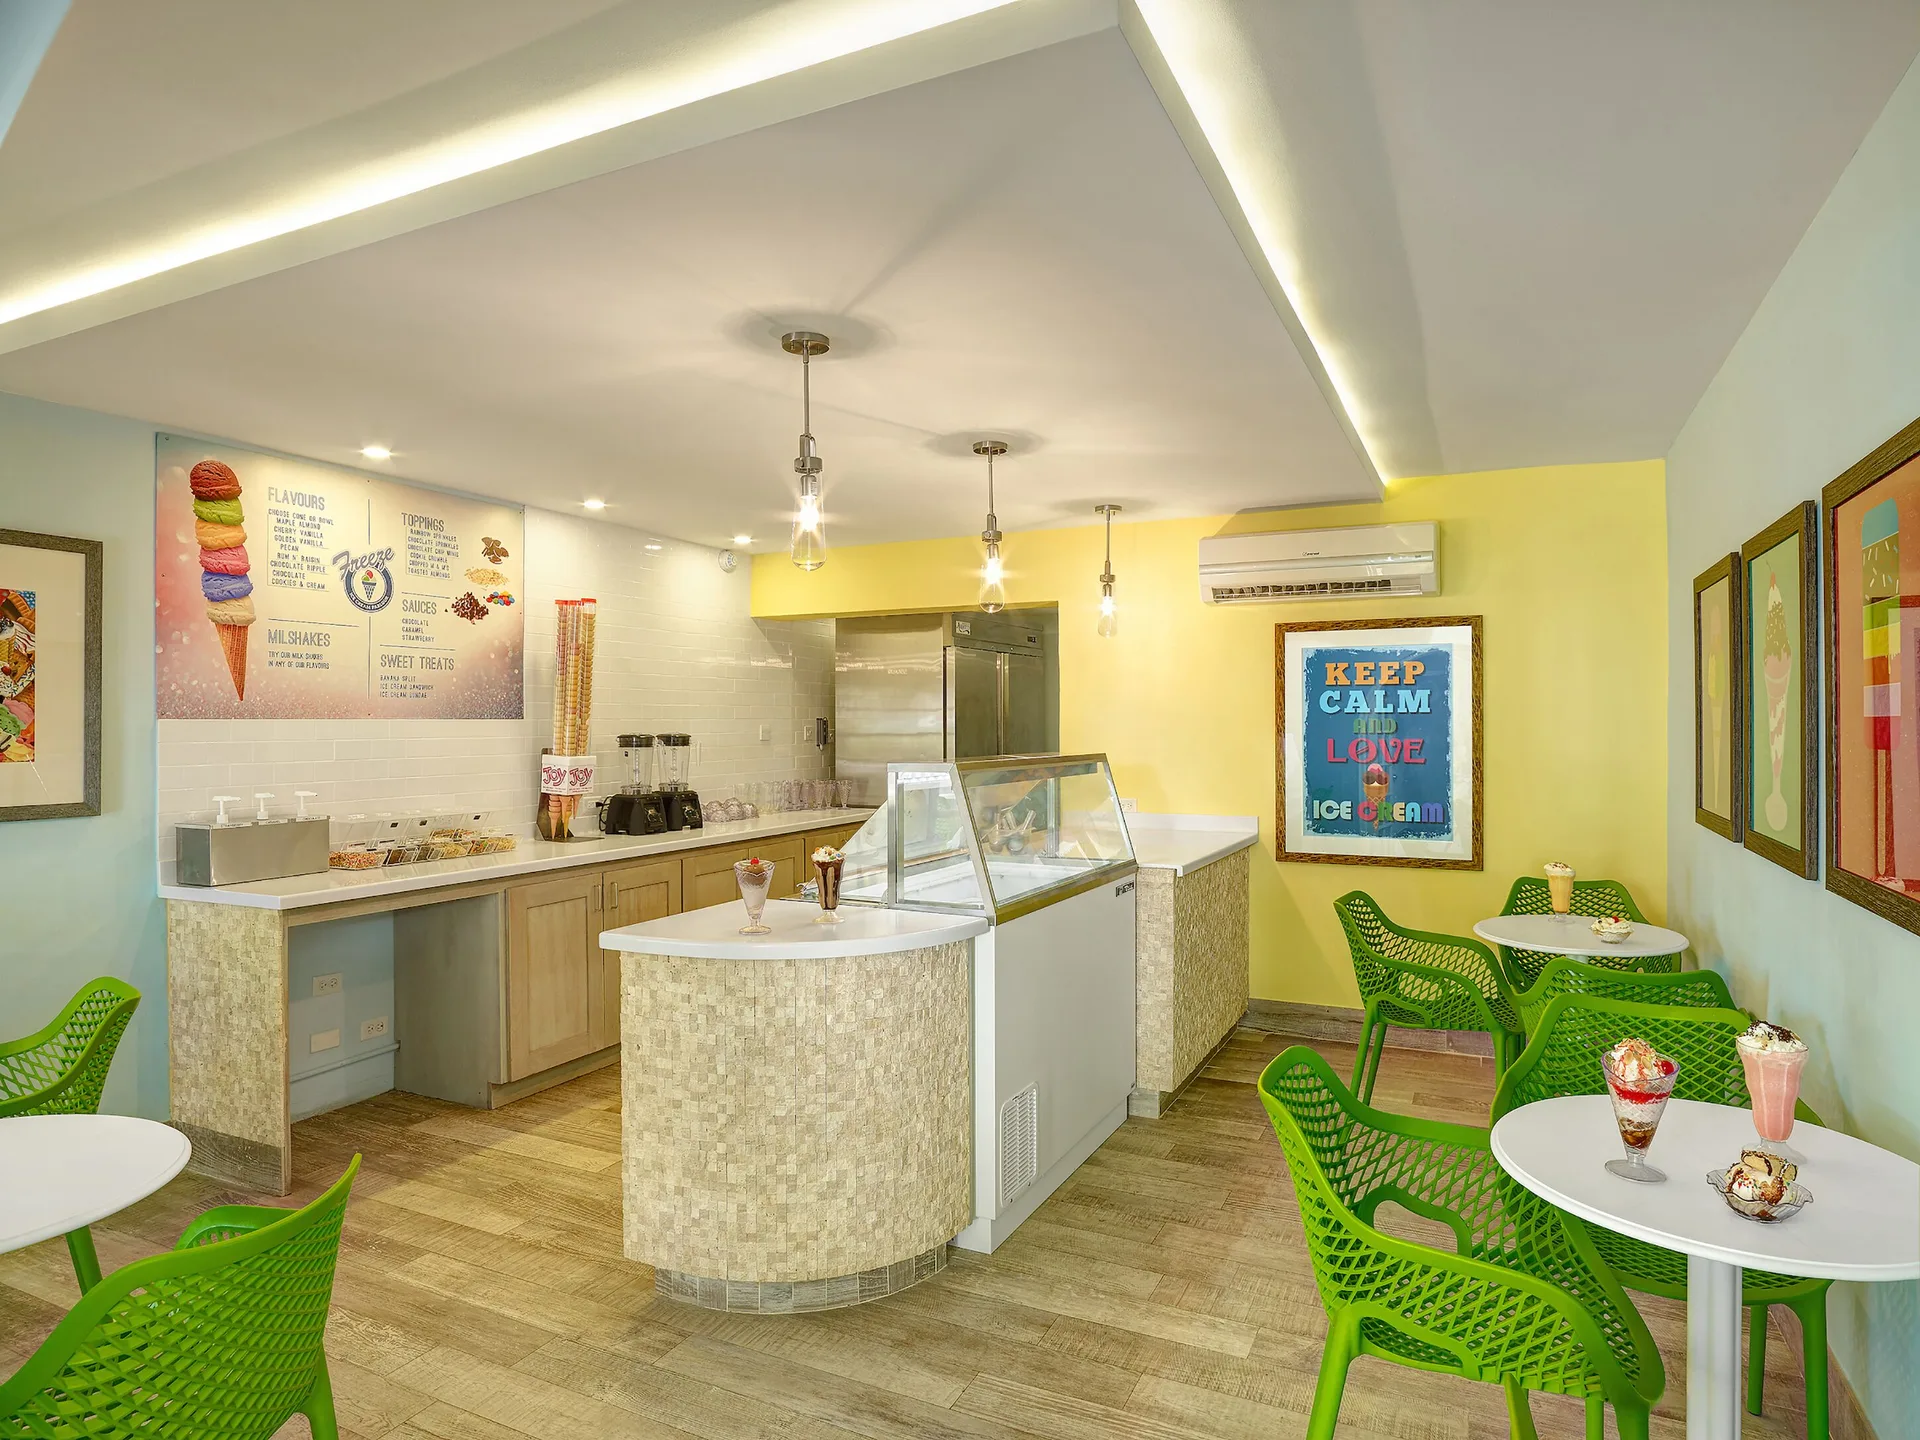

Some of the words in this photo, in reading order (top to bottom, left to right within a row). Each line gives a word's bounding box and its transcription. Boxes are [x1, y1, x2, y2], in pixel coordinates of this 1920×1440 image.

[268, 486, 325, 511] FLAVOURS
[268, 508, 289, 518] CHOOSE
[292, 512, 306, 521] CONE
[318, 516, 334, 526] BOWL
[276, 517, 295, 527] MAPLE
[299, 521, 321, 530] ALMOND
[401, 512, 445, 533] TOPPINGS
[273, 525, 296, 535] CHERRY
[300, 529, 323, 539] VANILLA
[410, 528, 431, 537] RAINBOW
[274, 534, 296, 543] GOLDEN
[299, 538, 323, 547] VANILLA
[280, 543, 299, 551] PECAN
[407, 536, 433, 546] CHOCOLATE
[407, 543, 433, 553] CHOCOLATE
[277, 552, 290, 560] RUM
[301, 555, 320, 563] RAISIN
[332, 547, 394, 580] Freeze
[270, 559, 304, 571] CHOCOLATE
[307, 564, 326, 573] RIPPLE
[407, 567, 428, 575] TOASTED
[272, 569, 306, 580] CHOCOLATE
[271, 578, 297, 587] COOKIES
[306, 582, 326, 590] CREAM
[402, 598, 437, 615] SAUCES
[401, 617, 429, 627] CHOCOLATE
[401, 626, 424, 634] CARAMEL
[268, 628, 331, 647] MILSHAKES
[401, 634, 435, 642] STRAWBERRY
[268, 650, 279, 658] TRY
[281, 651, 291, 659] OUR
[292, 652, 304, 660] MILK
[275, 660, 286, 668] ANY
[306, 661, 330, 670] FLAVOURS
[380, 654, 415, 669] SWEET
[419, 656, 455, 671] TREATS
[380, 674, 400, 682] BANANA
[1325, 661, 1426, 687] KEEP
[390, 691, 408, 699] CREAM
[1319, 689, 1432, 714] CALM
[1353, 717, 1398, 735] AND
[1327, 737, 1427, 764] LOVE
[1313, 799, 1353, 821] ICE
[1357, 801, 1445, 824] CREAM
